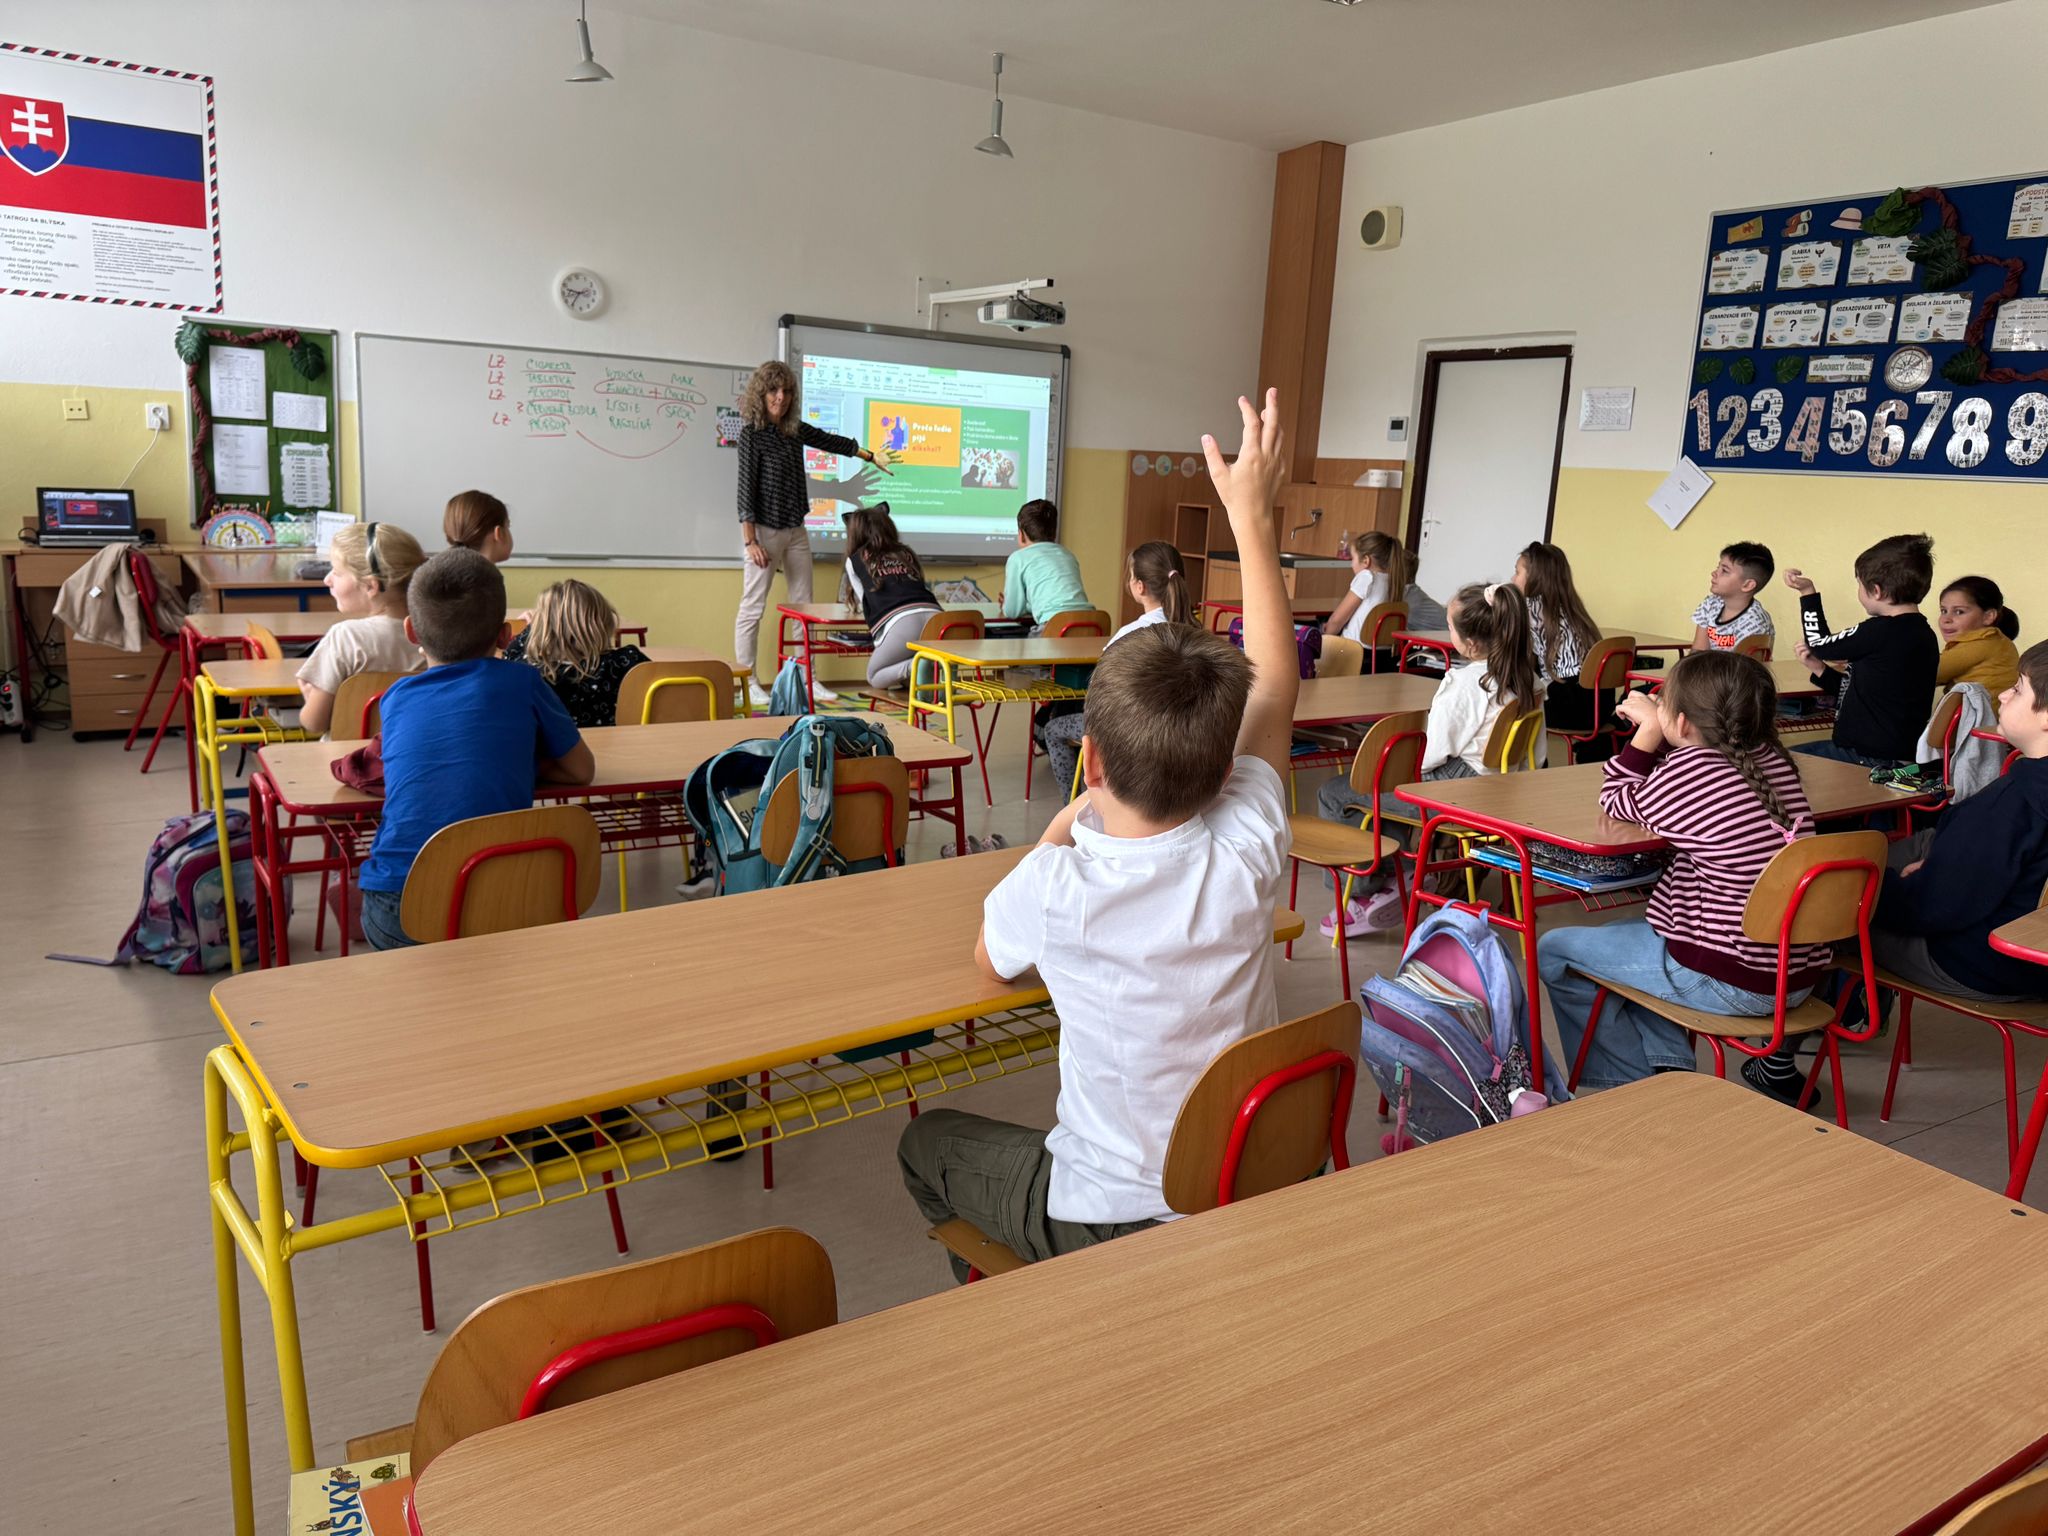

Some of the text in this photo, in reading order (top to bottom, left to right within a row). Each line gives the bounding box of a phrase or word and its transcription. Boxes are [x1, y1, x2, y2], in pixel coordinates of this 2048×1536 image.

[3, 214, 28, 222] TATROU
[1790, 319, 1797, 332] ?
[1689, 388, 1711, 452] 1
[1715, 395, 1748, 459] 2
[1747, 388, 1783, 452] 3
[1785, 397, 1826, 463] 4
[1828, 387, 1867, 455] 5
[1867, 399, 1909, 467] 6
[1908, 391, 1953, 460] 7
[1946, 397, 1992, 468] 8
[2005, 392, 2048, 466] 9
